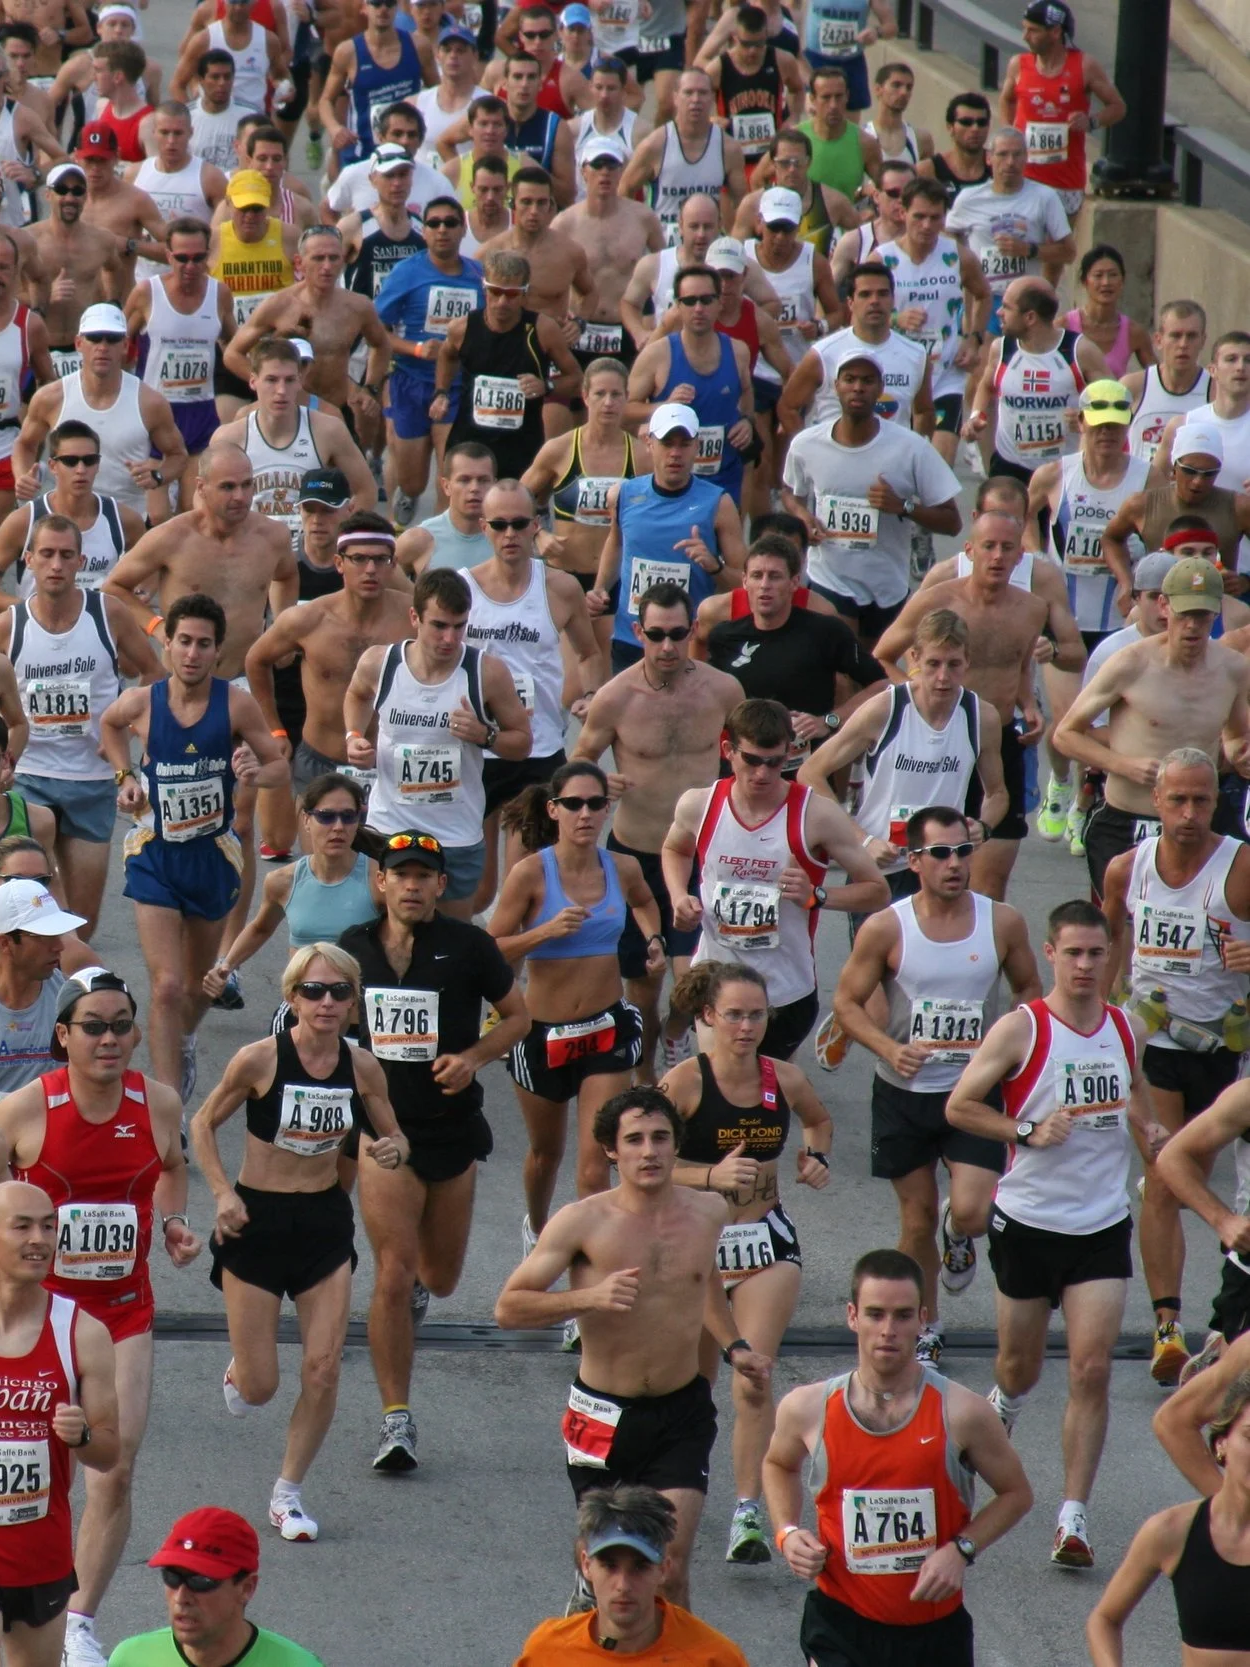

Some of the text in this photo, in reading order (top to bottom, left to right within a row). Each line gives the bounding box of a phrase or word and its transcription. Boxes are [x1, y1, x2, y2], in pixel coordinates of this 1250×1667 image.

[738, 122, 771, 140] A 885
[1029, 133, 1062, 149] A 864
[374, 246, 397, 258] SAN
[982, 257, 1026, 274] B 2840
[908, 290, 939, 302] Paul
[236, 310, 245, 326] A
[433, 300, 472, 318] A 938
[161, 361, 208, 380] A 1078
[475, 388, 524, 411] A 1586
[1004, 393, 1070, 410] NORWAY
[1015, 422, 1062, 441] A 1151
[579, 491, 588, 506] A
[827, 508, 870, 533] A 939
[1074, 504, 1116, 520] posc
[1067, 535, 1076, 554] A
[89, 557, 109, 572] Sole
[631, 572, 640, 593] A
[467, 624, 540, 643] Universal Sole
[25, 657, 96, 679] Universal Sole
[30, 694, 88, 716] A 1813
[389, 708, 438, 727] Universal
[402, 759, 453, 782] A 745
[895, 753, 941, 773] Universal
[163, 793, 223, 821] A 1351
[717, 856, 779, 869] FLEET FEET
[732, 866, 768, 879] Racing
[728, 902, 778, 927] 1794
[1139, 919, 1196, 951] A 547
[374, 1008, 429, 1035] A 796
[912, 1012, 981, 1041] A 1313
[564, 1033, 599, 1057] 294
[1065, 1075, 1120, 1105] A 906
[289, 1106, 345, 1133] A 988
[717, 1125, 782, 1140] DICK POND
[84, 1209, 126, 1219] LaSalle Bank
[58, 1224, 135, 1254] A 1039
[719, 1241, 773, 1272] 1116
[18, 1448, 37, 1458] Bank
[869, 1496, 920, 1505] LaSalle Bank
[854, 1511, 926, 1544] A 764
